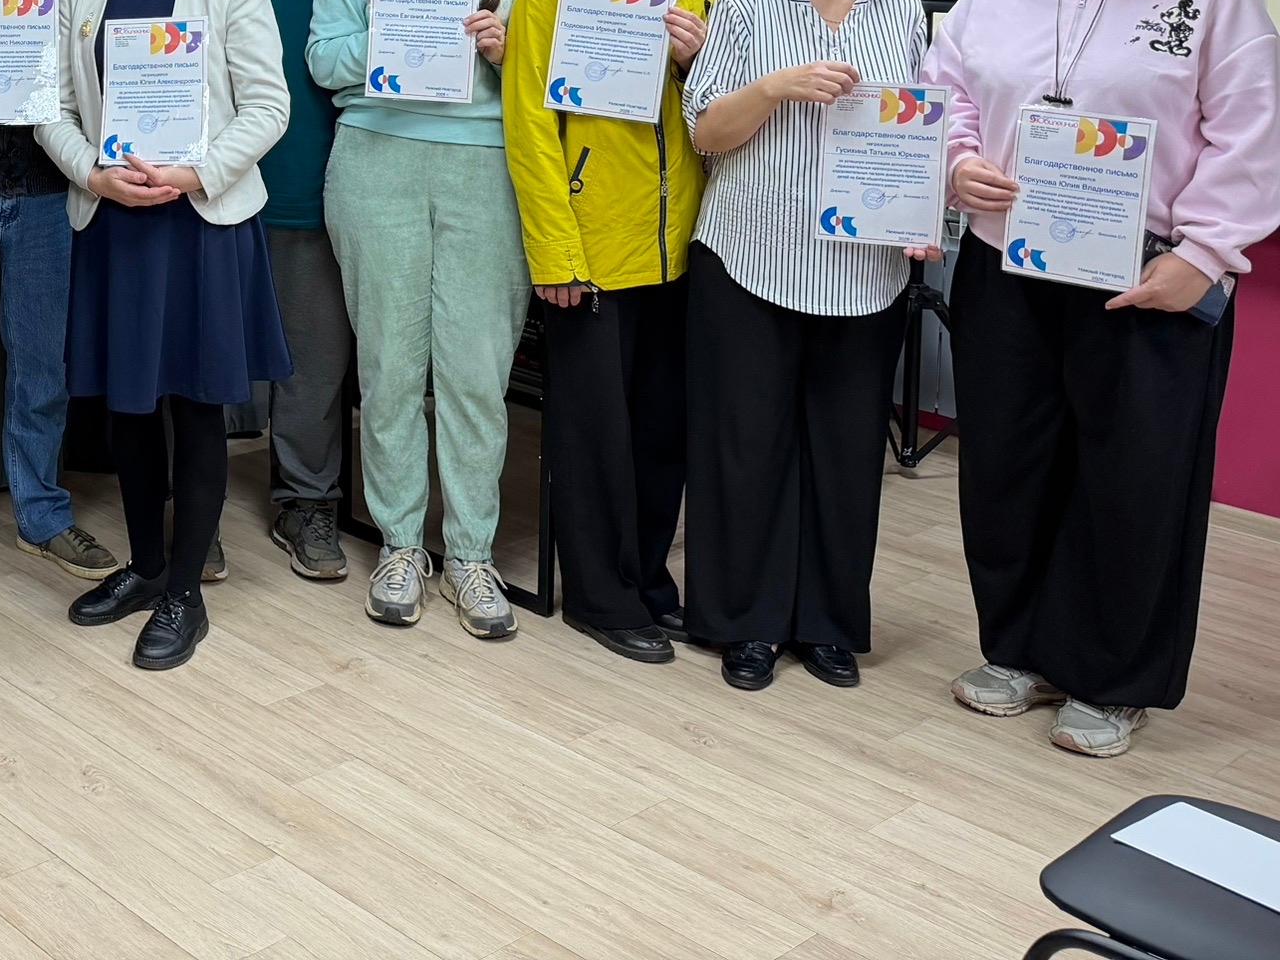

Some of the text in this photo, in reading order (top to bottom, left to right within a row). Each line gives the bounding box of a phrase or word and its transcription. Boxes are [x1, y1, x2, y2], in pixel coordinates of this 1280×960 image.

[567, 5, 662, 22] Благодарственное письмо
[618, 28, 663, 38] Вячеславовна
[113, 62, 173, 70] Благодарственное
[832, 128, 906, 140] Благодарственное
[898, 151, 930, 159] Юрьевна
[1024, 156, 1139, 178] Благодарственное письмо
[1019, 175, 1140, 198] Коркунова Юлия Владимировна
